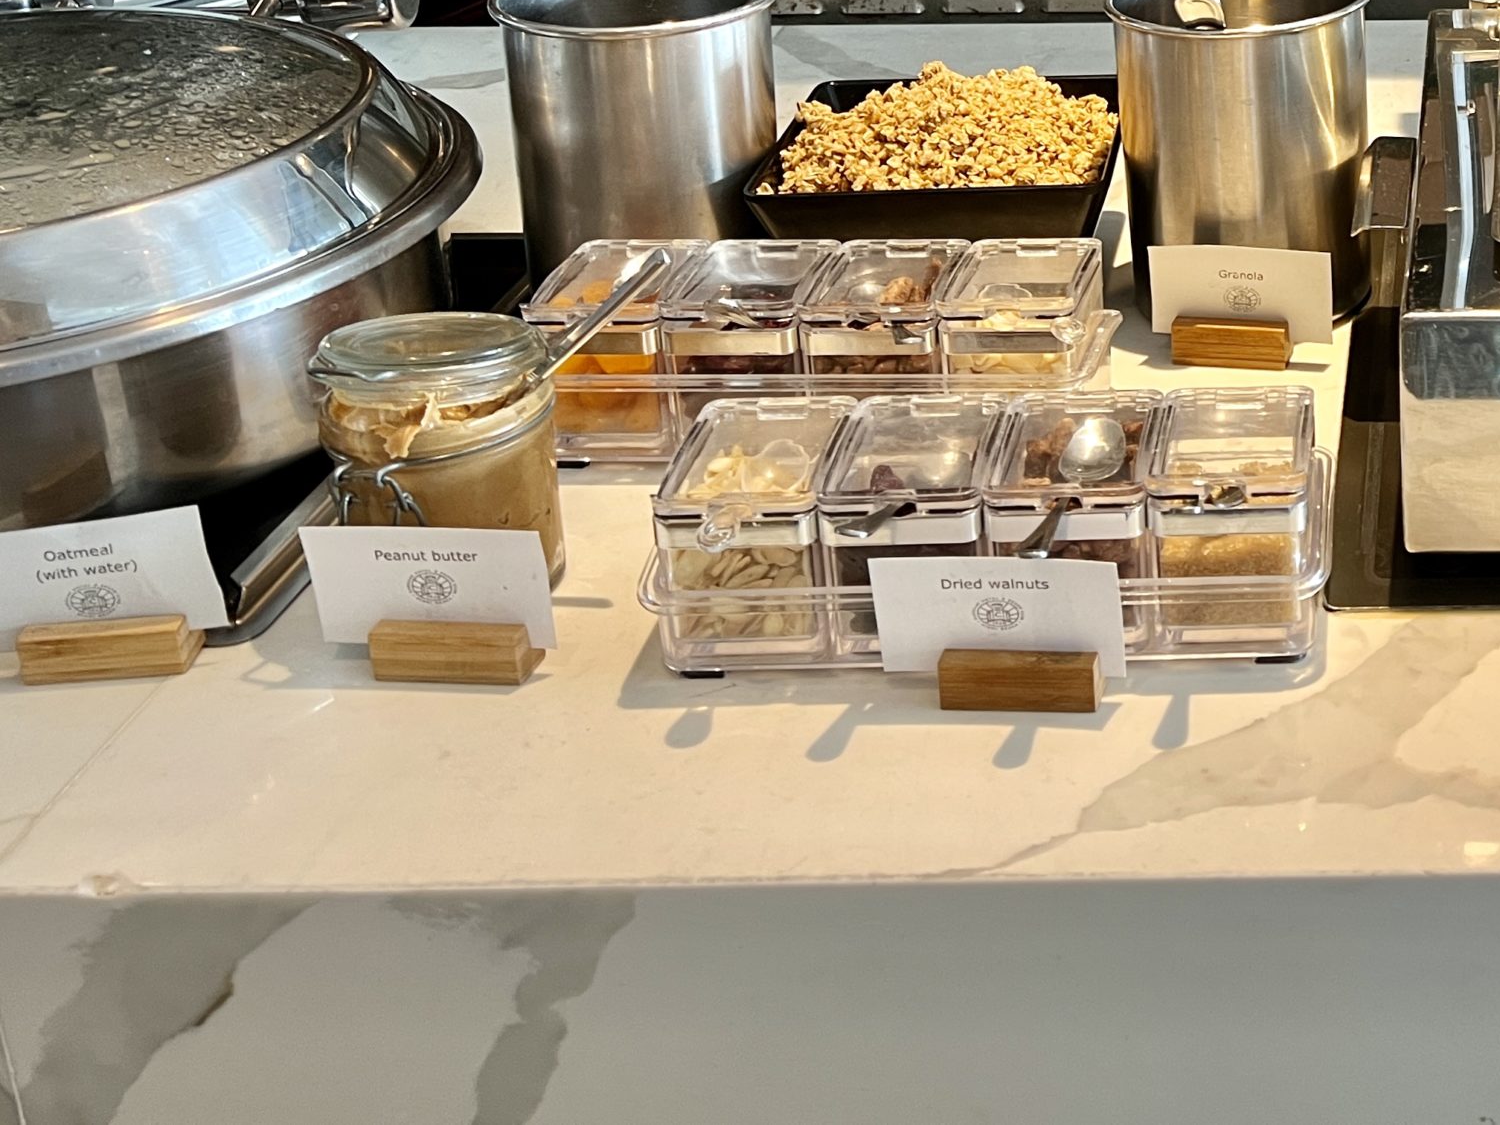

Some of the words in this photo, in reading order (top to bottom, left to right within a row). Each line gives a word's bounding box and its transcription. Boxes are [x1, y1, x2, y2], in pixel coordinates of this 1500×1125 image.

[1218, 269, 1264, 282] Granola
[43, 543, 113, 562] Oatmeal
[374, 549, 427, 562] Peanut
[431, 549, 479, 563] butter
[36, 565, 78, 584] (with
[84, 559, 138, 577] water)
[940, 578, 982, 590] Dried
[988, 578, 1049, 590] walnuts
